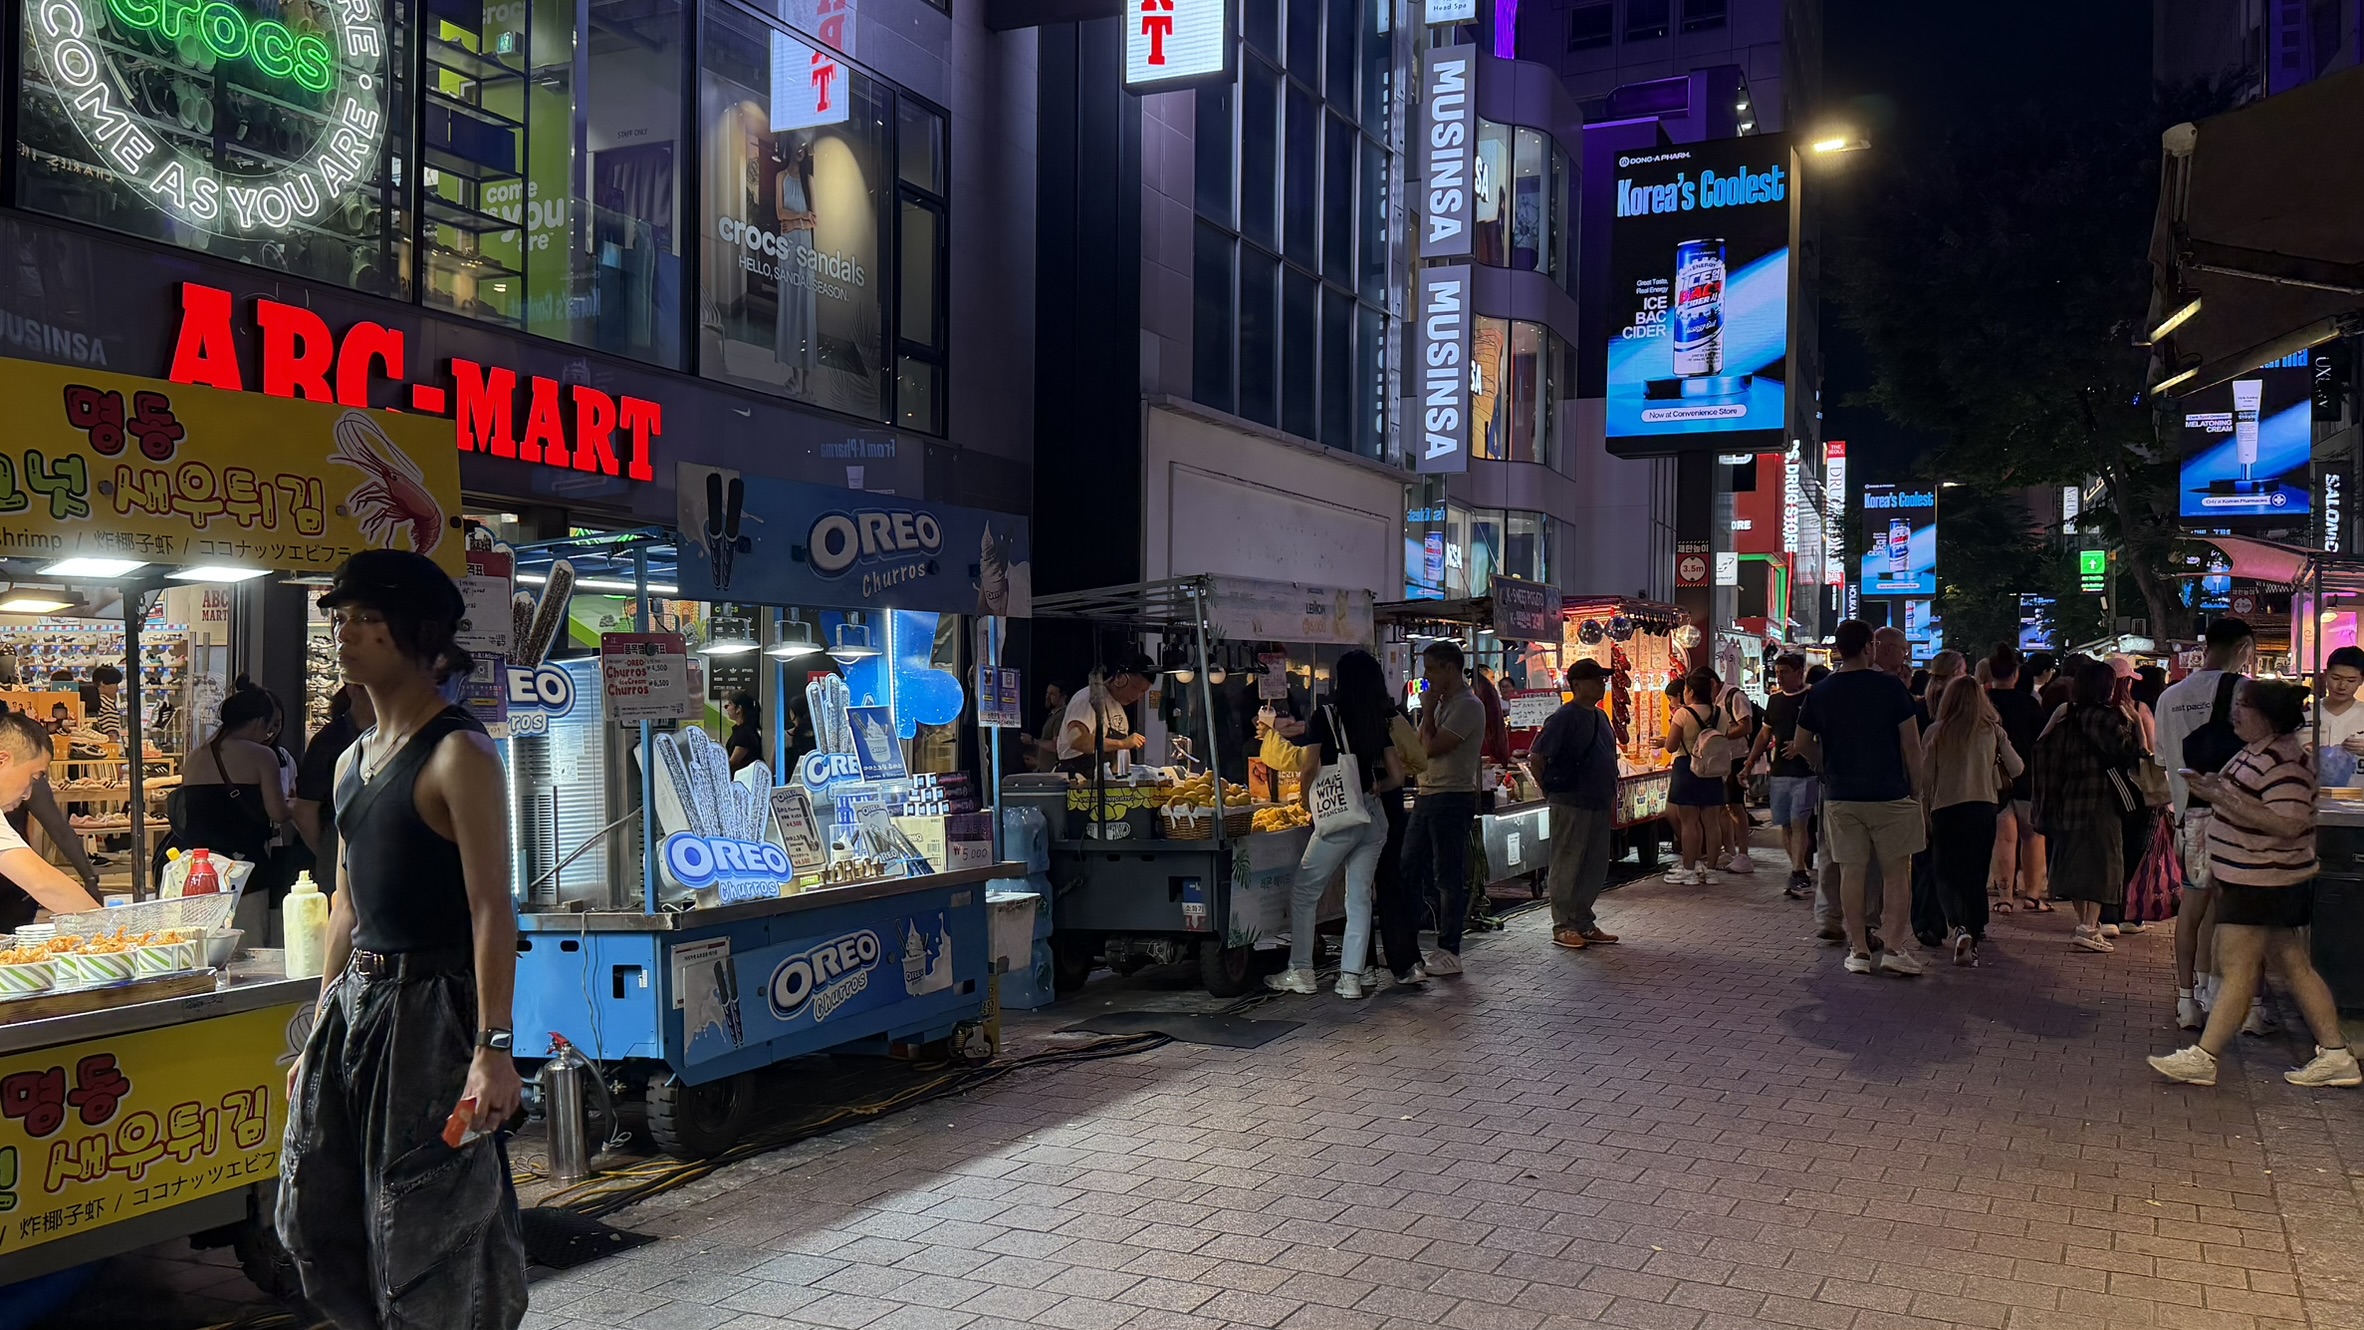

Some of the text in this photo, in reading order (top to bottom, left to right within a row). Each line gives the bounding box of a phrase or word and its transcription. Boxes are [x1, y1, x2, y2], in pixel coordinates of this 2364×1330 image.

[41, 4, 378, 229] COME AS YOU ARE
[1429, 59, 1466, 243] MUSINSA
[1617, 165, 1785, 217] Korea's Coolest
[500, 198, 565, 242] you
[718, 216, 865, 287] crocs sandals
[1636, 311, 1666, 324] BAC
[1644, 296, 1667, 310] ICE
[1622, 325, 1666, 339] CIDER
[169, 281, 661, 481] ABC-MART
[1425, 280, 1460, 460] MUSINSA
[63, 383, 186, 461] 명동
[1649, 410, 1664, 419] Now
[1673, 408, 1718, 418] Convenience
[1719, 407, 1737, 415] Store
[113, 461, 325, 537] 새우튀김
[1784, 462, 1800, 503] DRUG
[1864, 491, 1934, 509] Korea's Coolest
[94, 531, 173, 555] 炸椰子虾
[810, 512, 941, 571] OREO
[1677, 544, 1709, 553] 제한높이
[1784, 507, 1799, 553] STORE
[863, 562, 925, 598] Churros
[1683, 565, 1704, 574] 3.5m
[202, 590, 229, 608] ABC
[202, 610, 228, 622] MART
[1849, 585, 1858, 611] HOLIKA
[606, 666, 647, 678] Churros
[608, 684, 649, 696] Churros
[1317, 781, 1344, 799] WITH
[1317, 794, 1346, 813] LOVE
[672, 838, 786, 877] OREO
[720, 881, 777, 901] Churros
[775, 934, 876, 1008] OREO
[816, 973, 866, 1018] Churros
[2, 1052, 131, 1137] 명동
[44, 1085, 268, 1194] 새우튀김
[20, 1197, 105, 1239] 炸椰子虾
